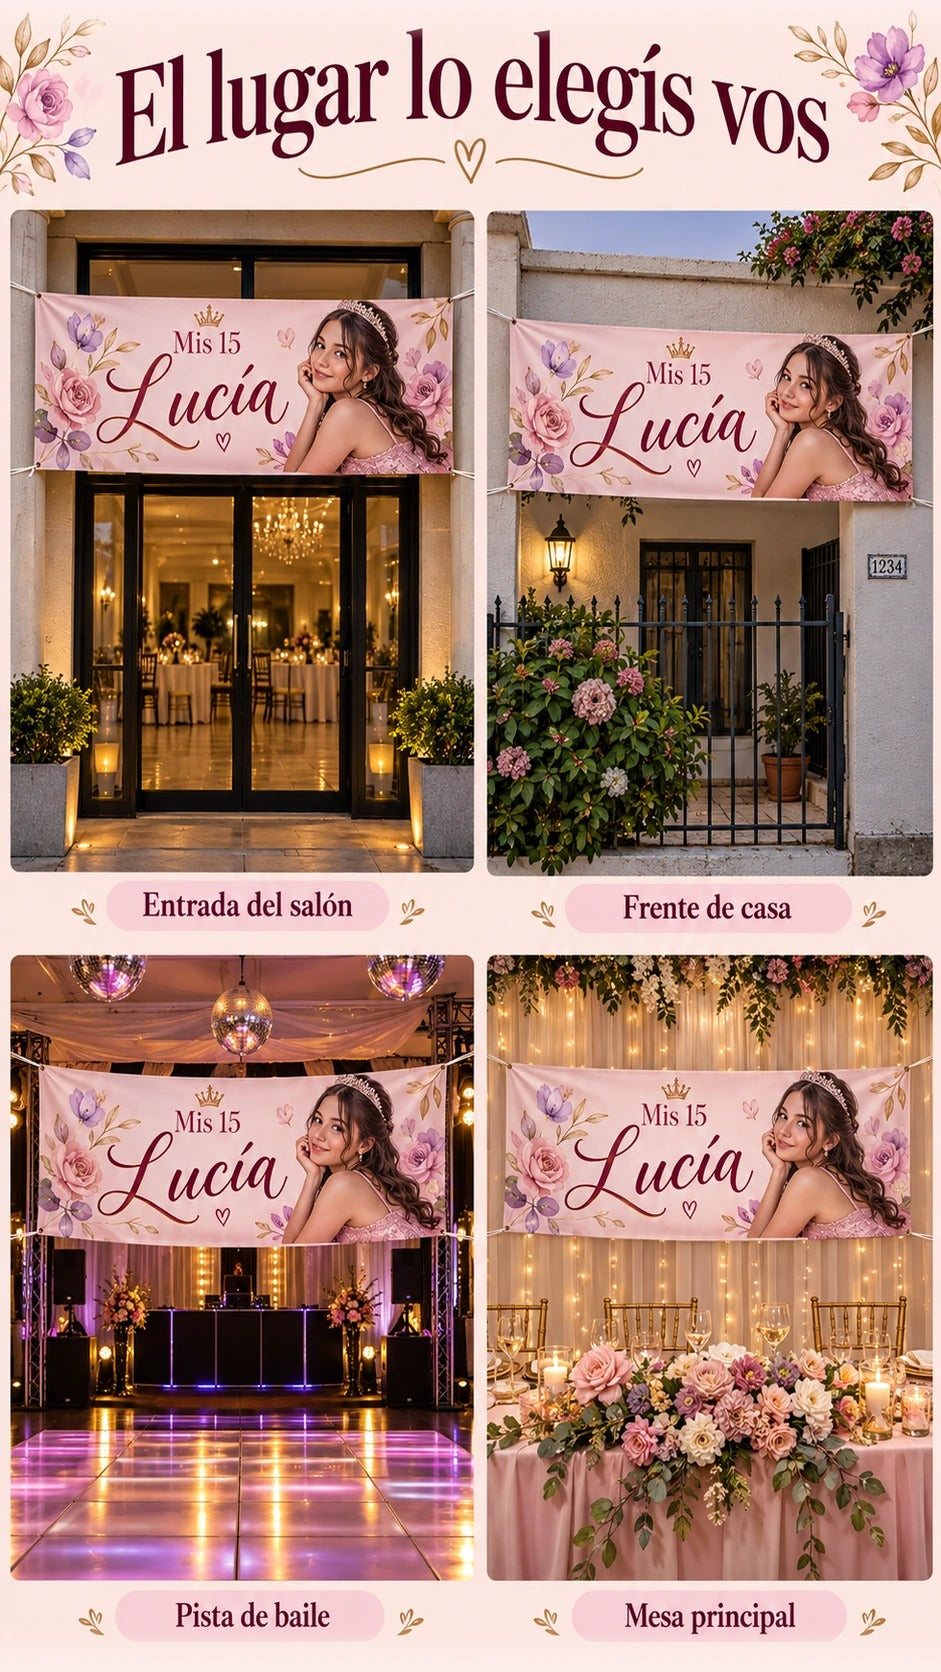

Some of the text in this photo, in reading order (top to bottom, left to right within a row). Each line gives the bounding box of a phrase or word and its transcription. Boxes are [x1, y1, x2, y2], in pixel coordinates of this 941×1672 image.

[173, 330, 241, 355] Mis 15
[646, 360, 712, 386] Mis 15
[96, 352, 290, 452] Lucía
[569, 381, 758, 476] Lucía
[872, 559, 902, 574] 1234
[174, 1109, 241, 1134] Mis 15
[641, 1102, 707, 1127] Mis 15
[96, 1131, 288, 1224] Lucía
[564, 1124, 754, 1218] Lucía
